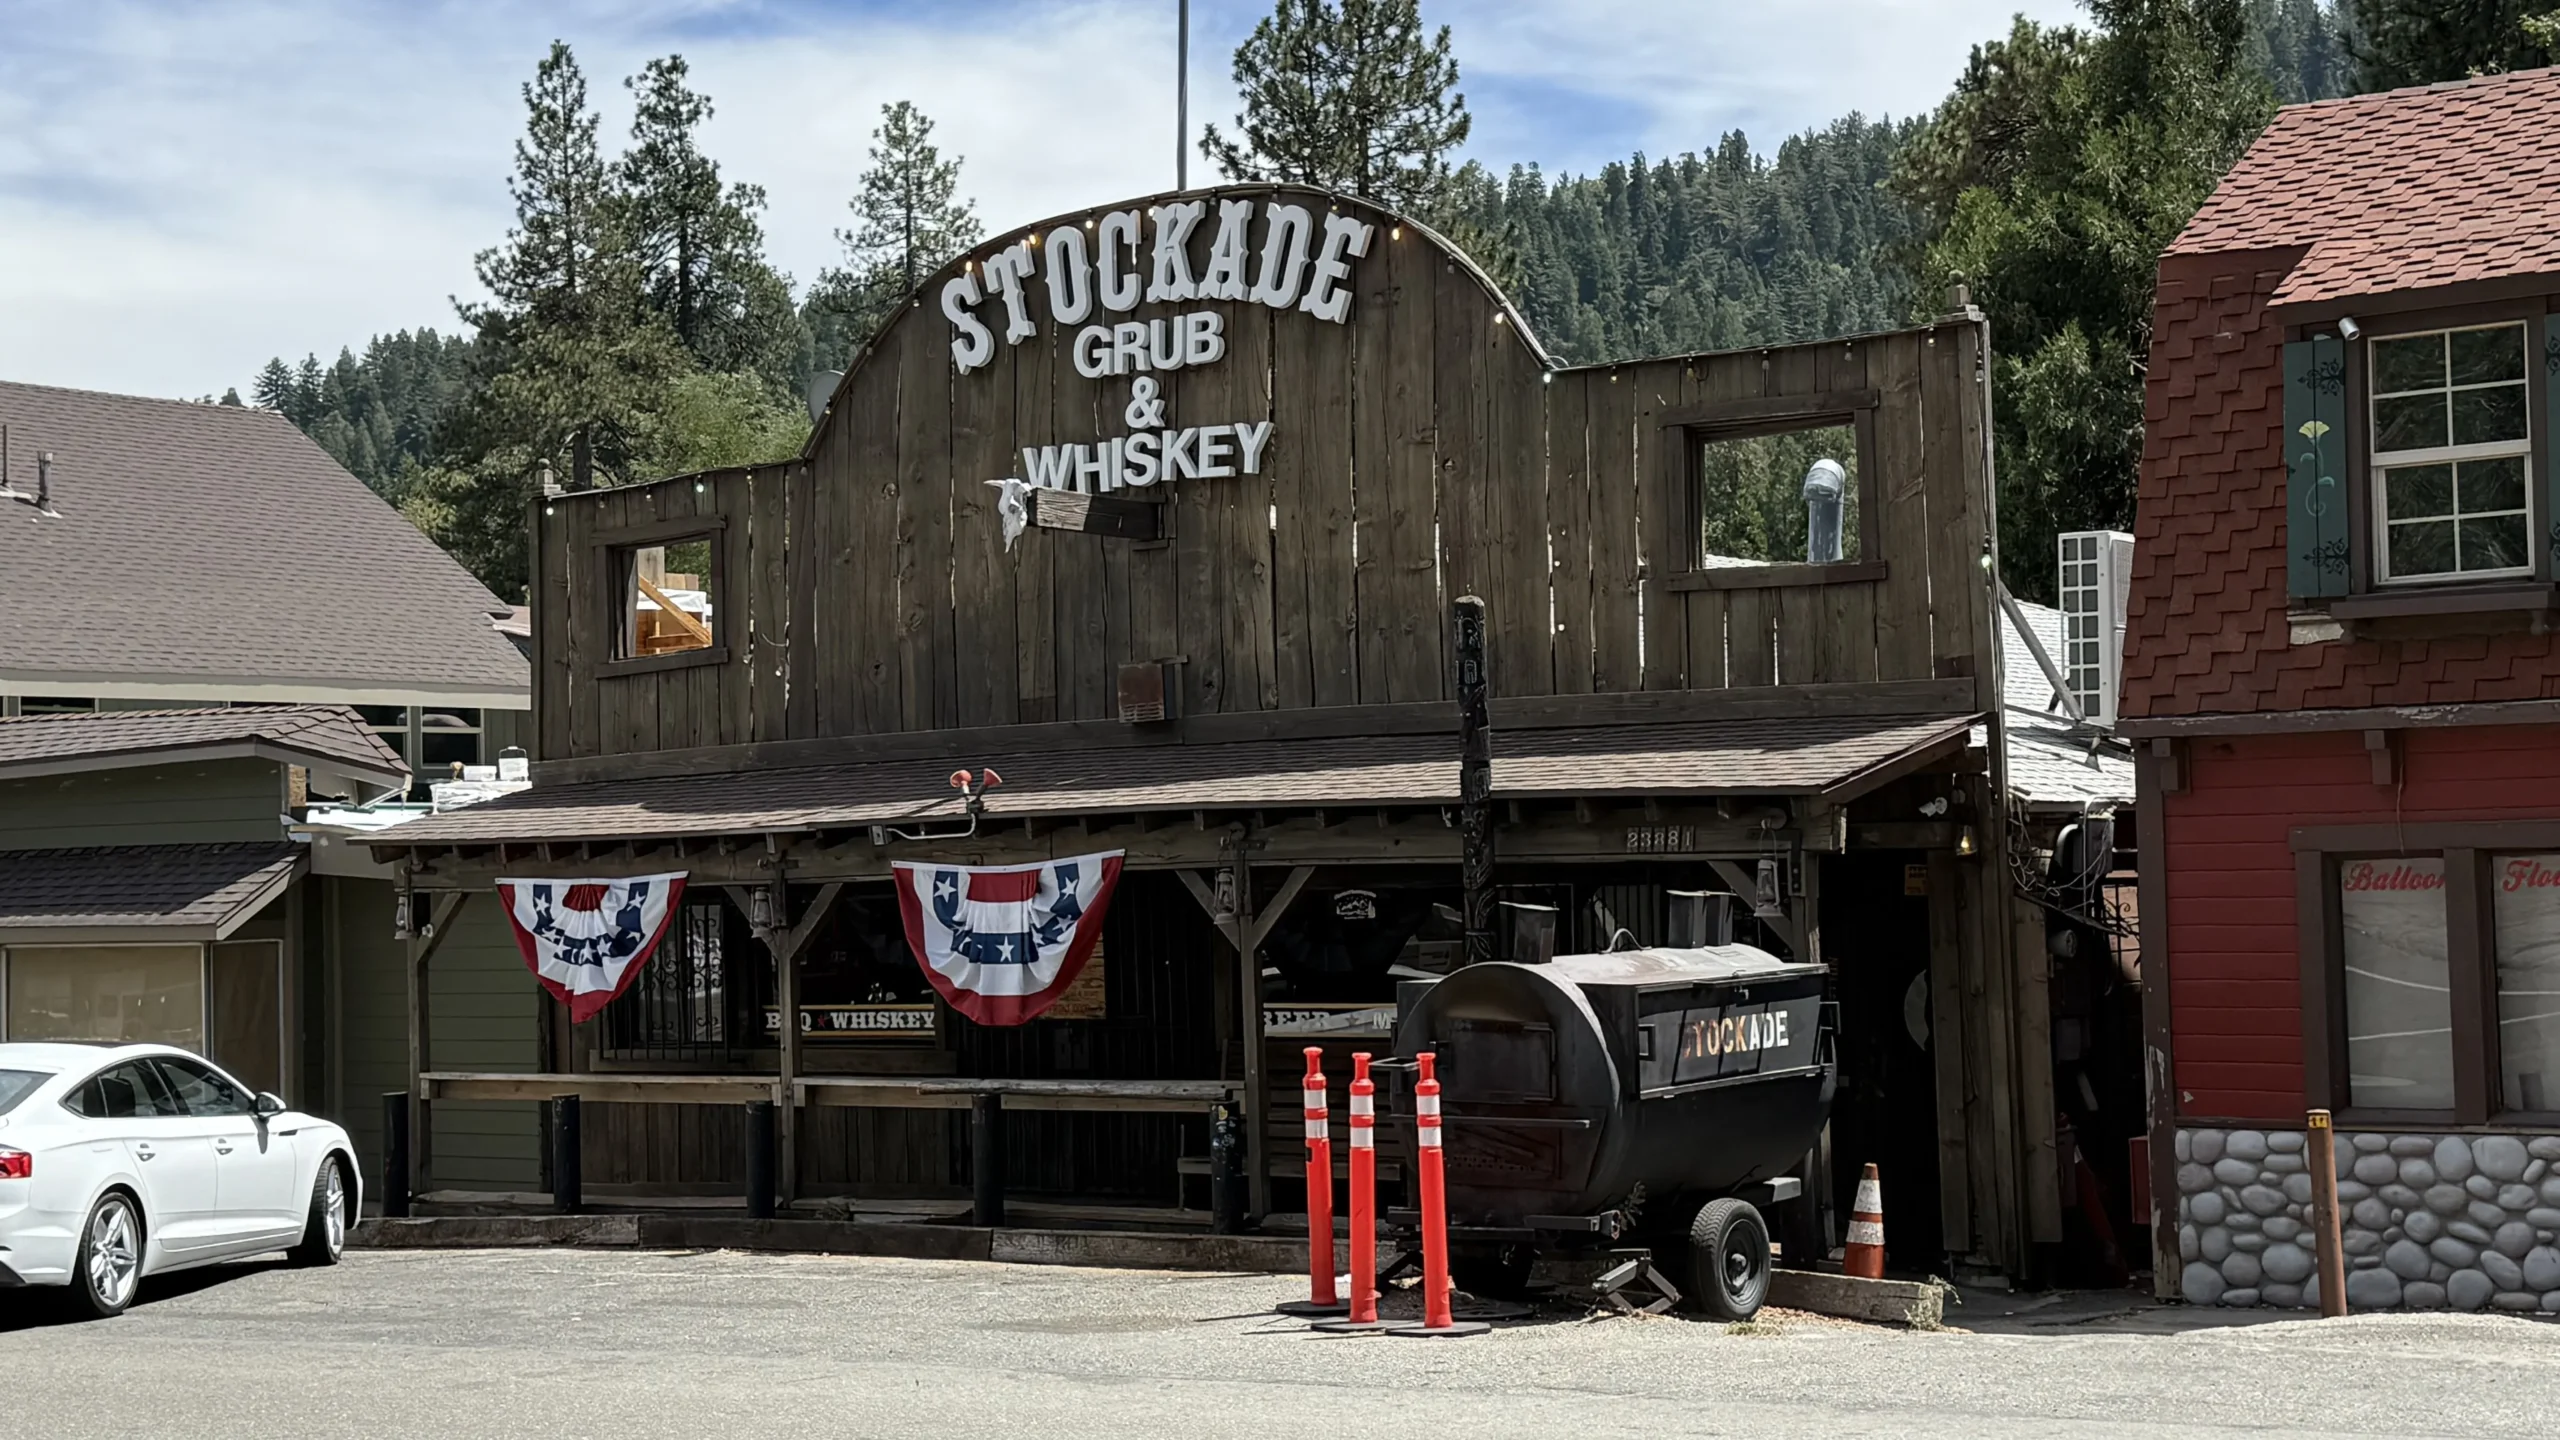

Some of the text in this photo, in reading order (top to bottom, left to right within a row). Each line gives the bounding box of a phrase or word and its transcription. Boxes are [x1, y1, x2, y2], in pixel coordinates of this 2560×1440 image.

[941, 199, 1374, 375] STOCKADE
[1073, 311, 1225, 378] GRUB
[1125, 376, 1166, 431] &
[1023, 421, 1275, 494] WHISKEY
[765, 1012, 935, 1031] BQ WHISKEY
